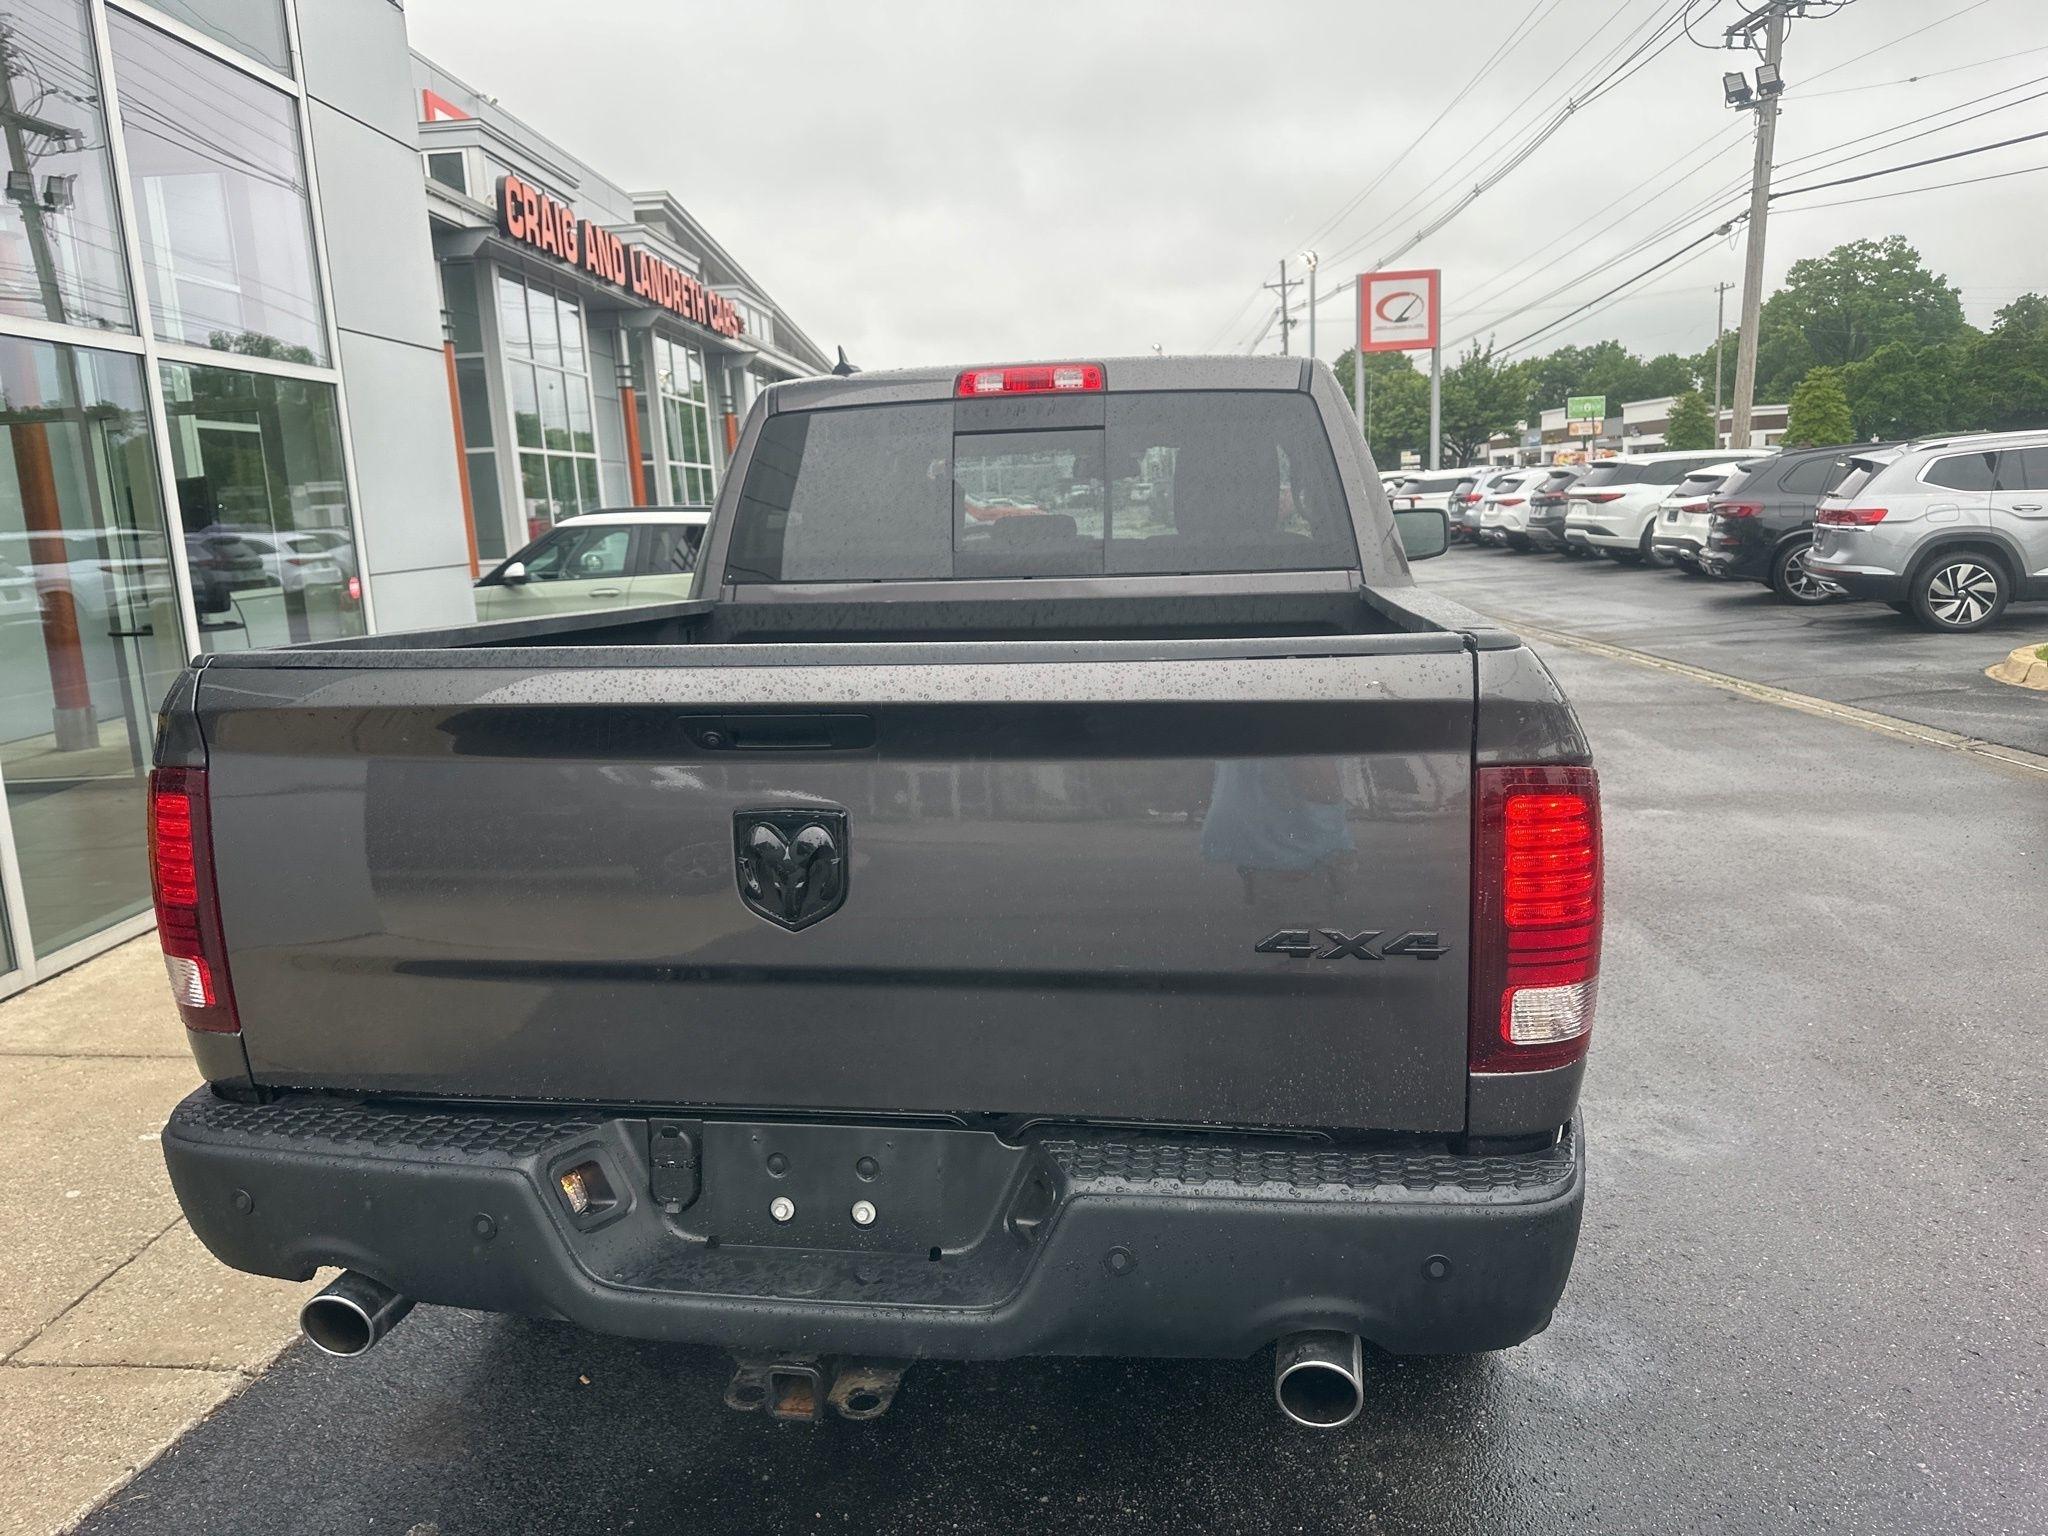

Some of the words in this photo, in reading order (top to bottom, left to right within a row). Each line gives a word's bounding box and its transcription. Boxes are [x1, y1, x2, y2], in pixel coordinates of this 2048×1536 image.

[501, 174, 579, 265] CRAIG
[584, 219, 626, 287] AND
[629, 244, 708, 326] LANDRETH
[707, 288, 740, 340] CARS
[1255, 928, 1451, 961] 4X4
